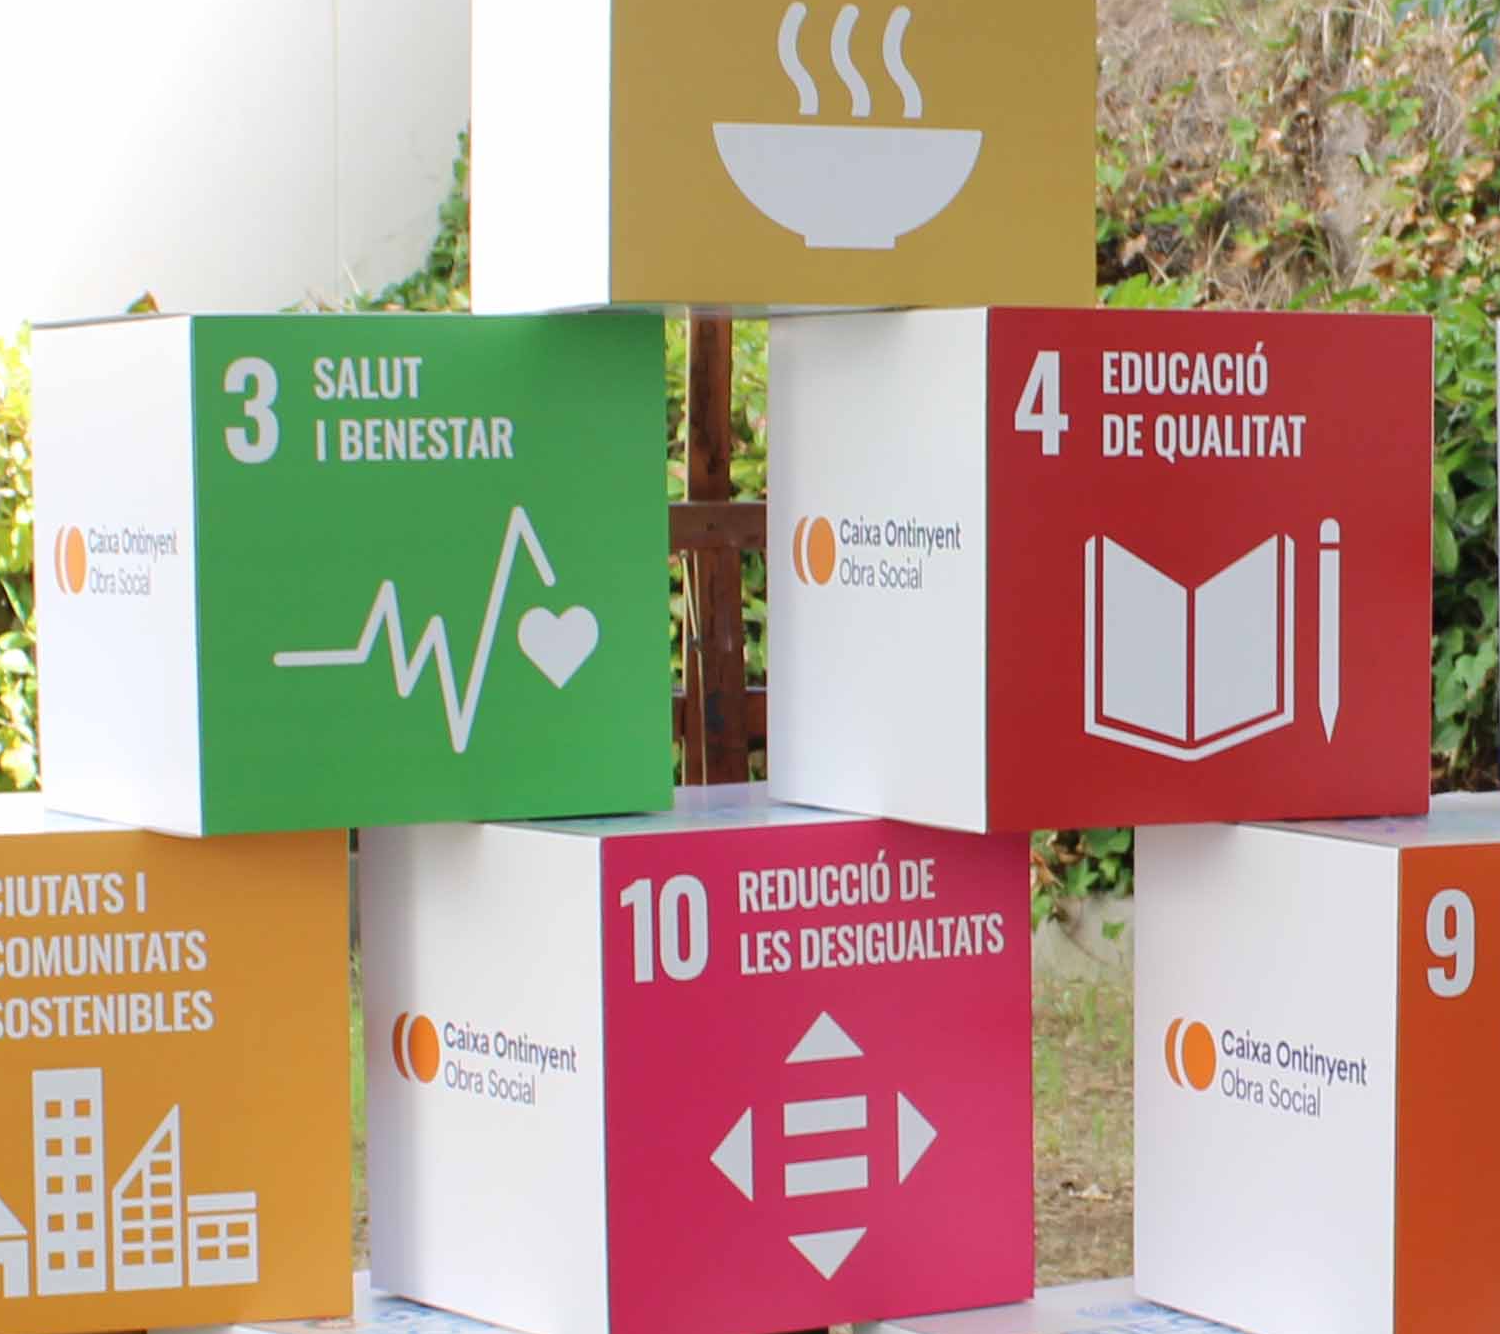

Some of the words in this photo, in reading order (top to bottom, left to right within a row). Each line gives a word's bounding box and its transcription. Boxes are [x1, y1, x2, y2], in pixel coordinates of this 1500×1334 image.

[313, 357, 422, 400] SALUT
[1103, 342, 1269, 396] EDUCACIÓ
[223, 356, 280, 463] 3
[1014, 350, 1069, 455] 4
[316, 419, 326, 461] I
[340, 417, 514, 461] BENESTAR
[1103, 415, 1143, 457] DE
[1154, 414, 1307, 464] QUALITAT
[88, 525, 119, 554] Caixa
[122, 526, 178, 558] Ontinyent
[839, 516, 881, 547] Caixa
[885, 519, 960, 557] Ontinyent
[90, 567, 116, 594] Obra
[119, 567, 151, 595] Social
[839, 557, 875, 587] Obra
[880, 559, 922, 590] Social
[136, 871, 147, 913] I
[738, 849, 891, 913] REDUCCIÓ
[899, 859, 936, 901] DE
[620, 874, 709, 983] 10
[739, 930, 791, 975] LES
[801, 913, 1004, 969] DESIGUALTATS
[1425, 888, 1476, 998] 9
[443, 1022, 489, 1055] Caixa
[494, 1031, 577, 1074] Ontinyent
[1221, 1029, 1271, 1065] Caixa
[1276, 1041, 1367, 1086] Ontinyent
[444, 1058, 484, 1094] Obra
[488, 1069, 536, 1106] Social
[1221, 1068, 1264, 1104] Obra
[1269, 1078, 1320, 1118] Social
